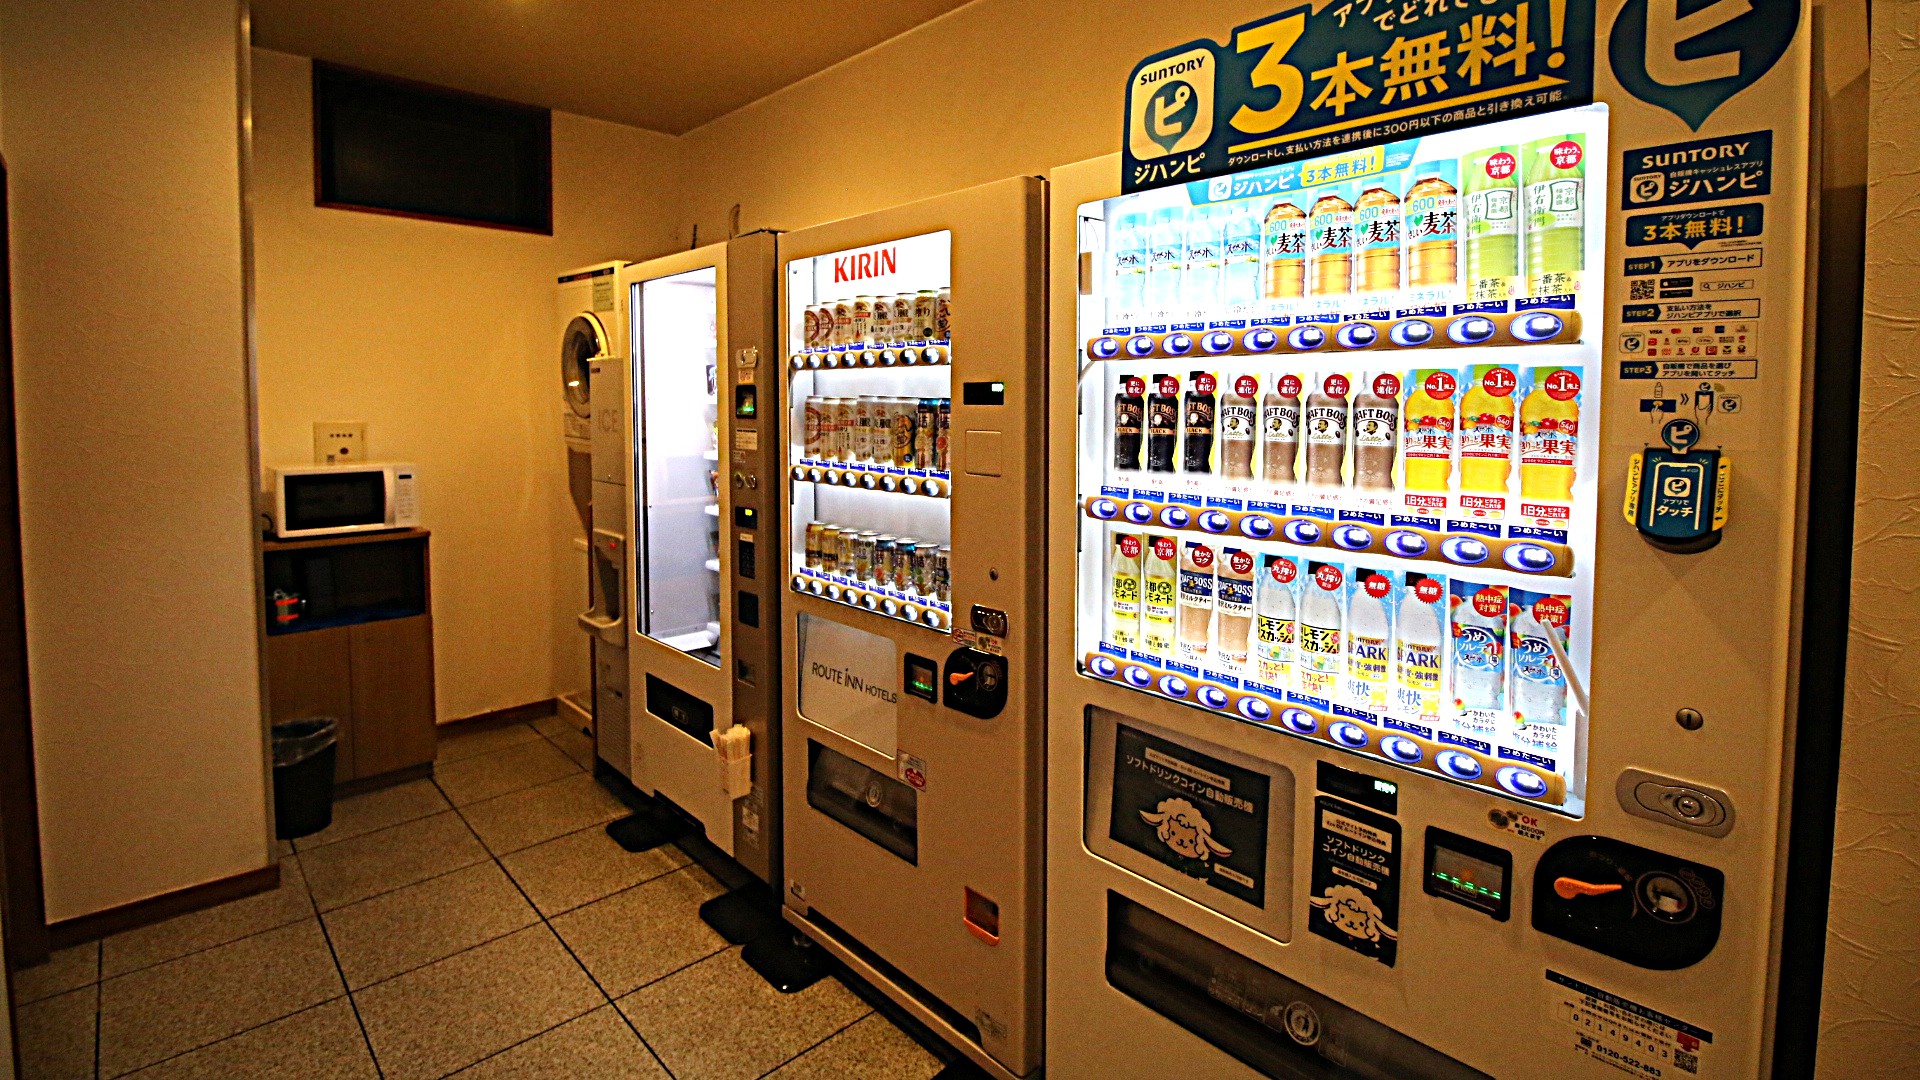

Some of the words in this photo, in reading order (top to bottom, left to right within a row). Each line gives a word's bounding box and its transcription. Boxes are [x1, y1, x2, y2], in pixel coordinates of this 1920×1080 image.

[1140, 56, 1205, 86] SUNTORY
[1555, 155, 1576, 166] 京都
[1641, 141, 1750, 169] SUNTORY
[1134, 152, 1206, 184] ジハンピ
[1305, 155, 1375, 183] 3本無料!
[1490, 166, 1510, 175] 京都
[1234, 173, 1293, 196] ジハンピ
[1669, 170, 1764, 197] ジハンピ
[1412, 197, 1435, 211] 600
[1359, 206, 1379, 220] 600
[1661, 209, 1725, 221] アプリダウンロードで
[1269, 220, 1287, 232] 600
[1314, 214, 1333, 227] 600
[1423, 211, 1457, 236] 麦茶
[1368, 219, 1400, 242] 麦茶
[1642, 215, 1743, 241] 3本無料!
[1277, 233, 1306, 254] 麦茶
[1322, 227, 1353, 248] 麦茶
[834, 247, 896, 283] KIRIN
[1627, 261, 1655, 270] STEP1
[1667, 254, 1755, 268] アプリをダウンロード
[1625, 308, 1655, 317] STEP2
[1623, 365, 1652, 374] STEP3
[1662, 498, 1689, 506] アプリで
[1656, 505, 1694, 517] タッチ
[1122, 545, 1138, 554] 京都
[1156, 547, 1173, 556] 京都
[1234, 563, 1248, 571] コク
[1475, 594, 1502, 604] 熱中症
[1479, 603, 1501, 613] 対策!
[1535, 603, 1565, 614] 熱中症
[1260, 618, 1285, 631] レモン
[1303, 627, 1329, 641] レモン
[1462, 630, 1487, 643] うめ
[1521, 641, 1548, 654] うめ
[811, 662, 842, 686] ROUTE
[865, 686, 897, 704] HOTELS
[1522, 815, 1539, 827] OK
[1326, 835, 1386, 863] ソフトドリンク
[1322, 843, 1390, 876] コイン自動販売機
